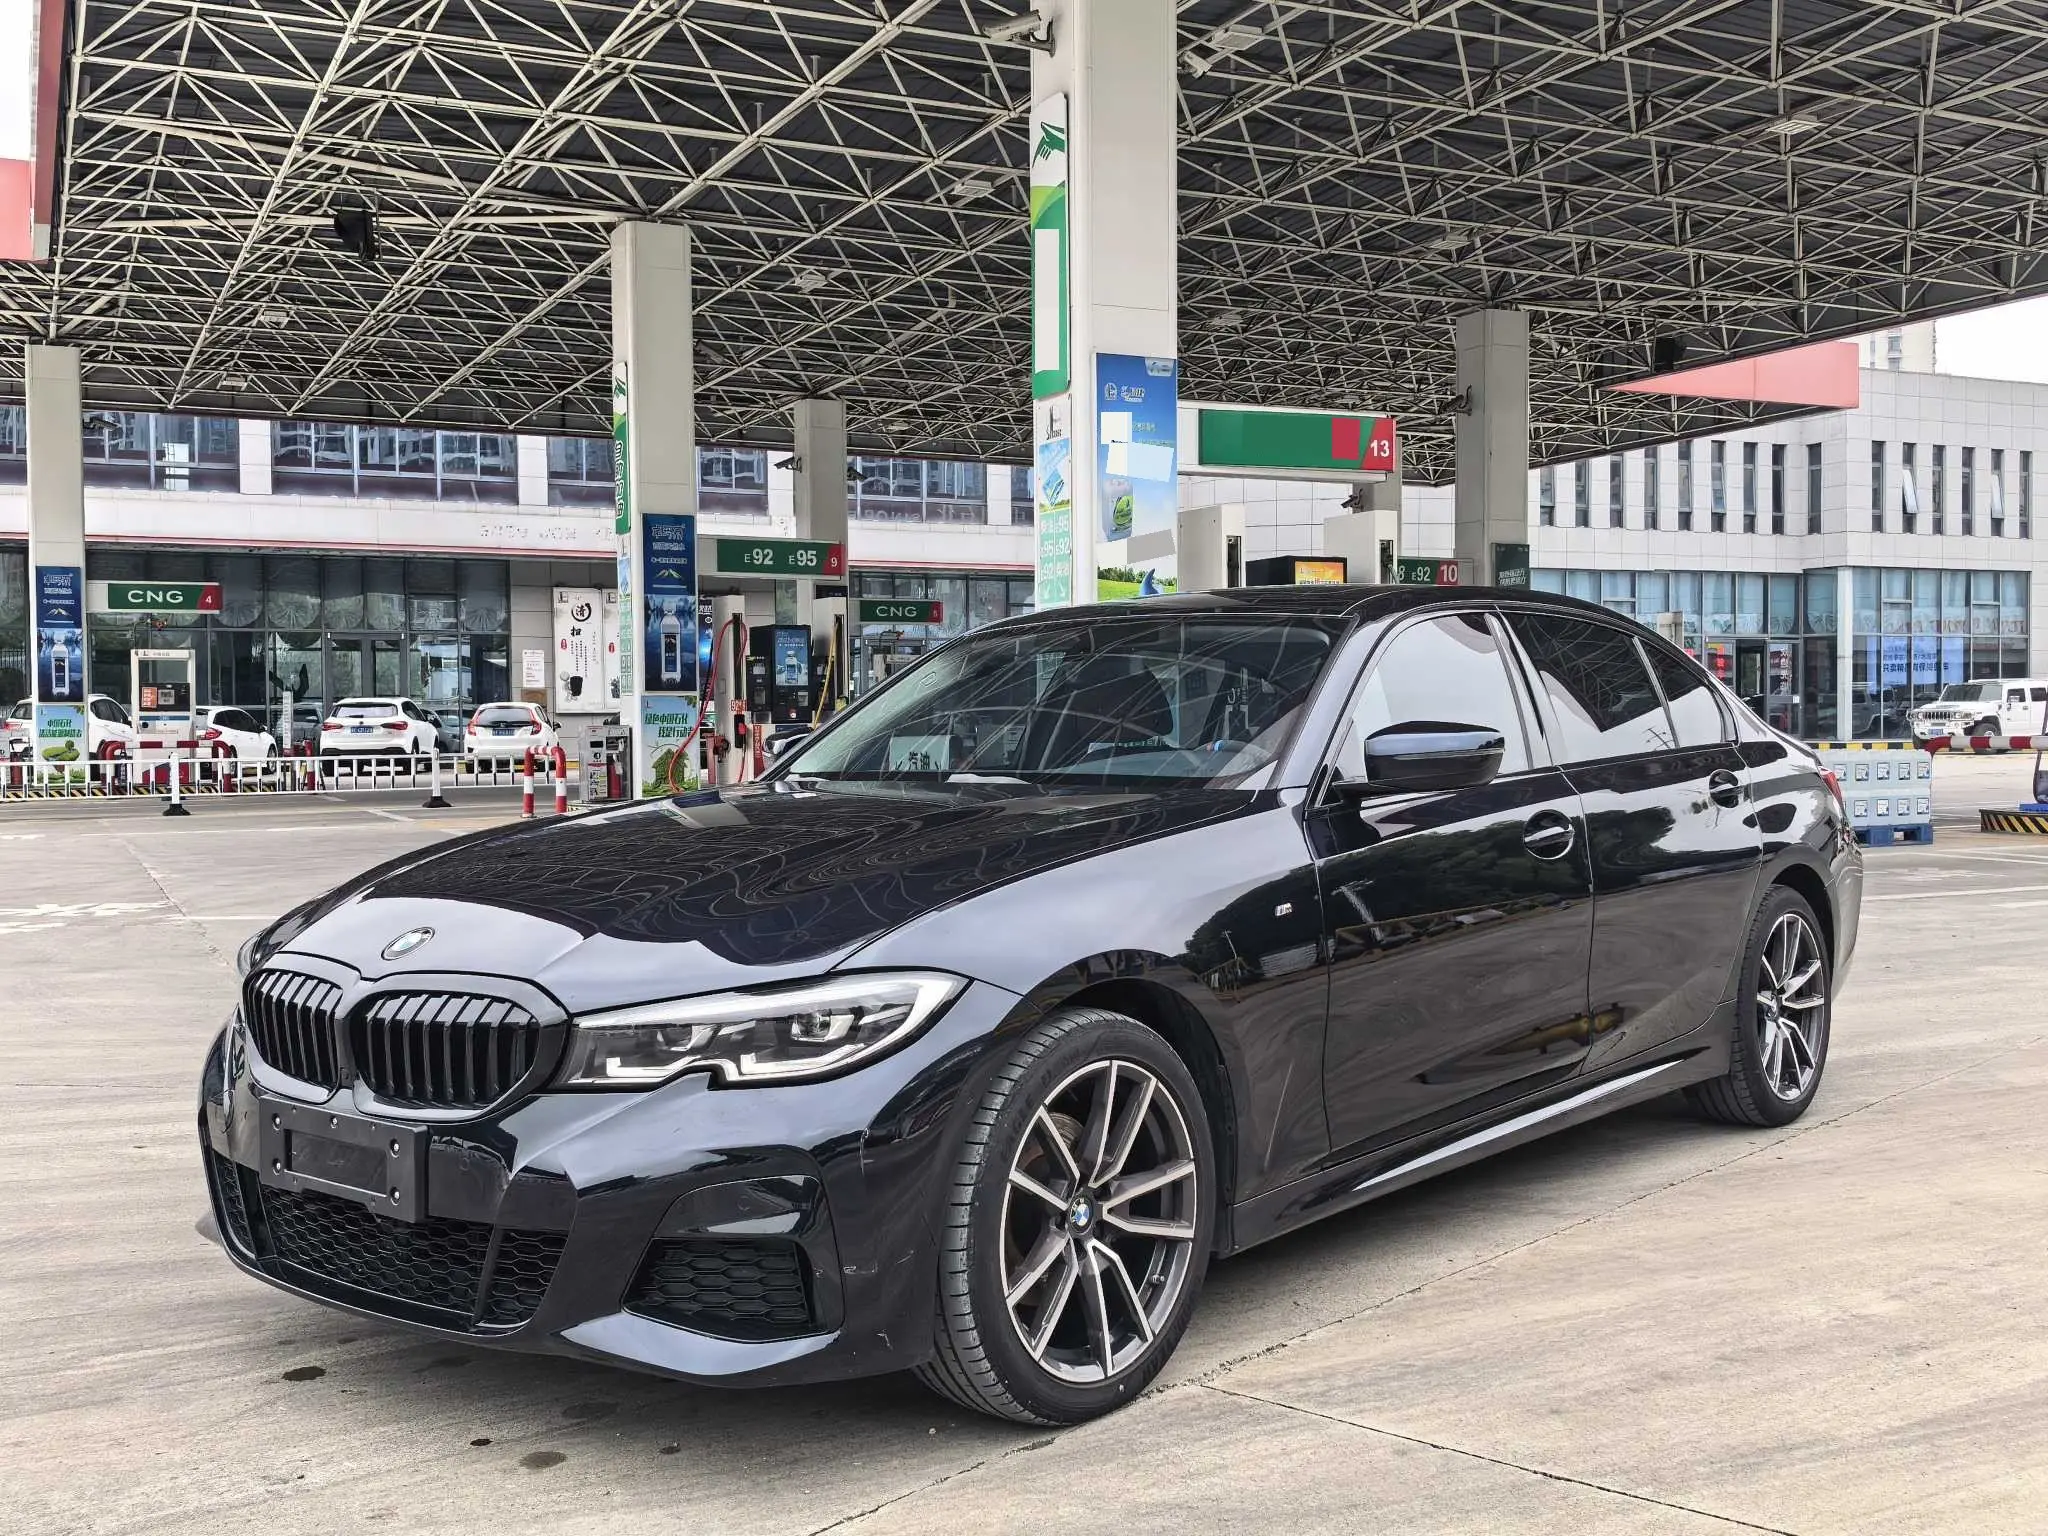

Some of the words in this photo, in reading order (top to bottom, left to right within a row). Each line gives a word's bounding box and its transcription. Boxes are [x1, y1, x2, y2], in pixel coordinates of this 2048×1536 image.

[1370, 439, 1390, 458] 13
[744, 549, 774, 565] E92
[788, 550, 817, 566] E95
[830, 557, 838, 567] 9
[1411, 566, 1431, 581] E92
[1440, 564, 1458, 583] 10
[127, 590, 184, 603] CNG
[205, 596, 212, 604] 4
[875, 605, 917, 617] CNG
